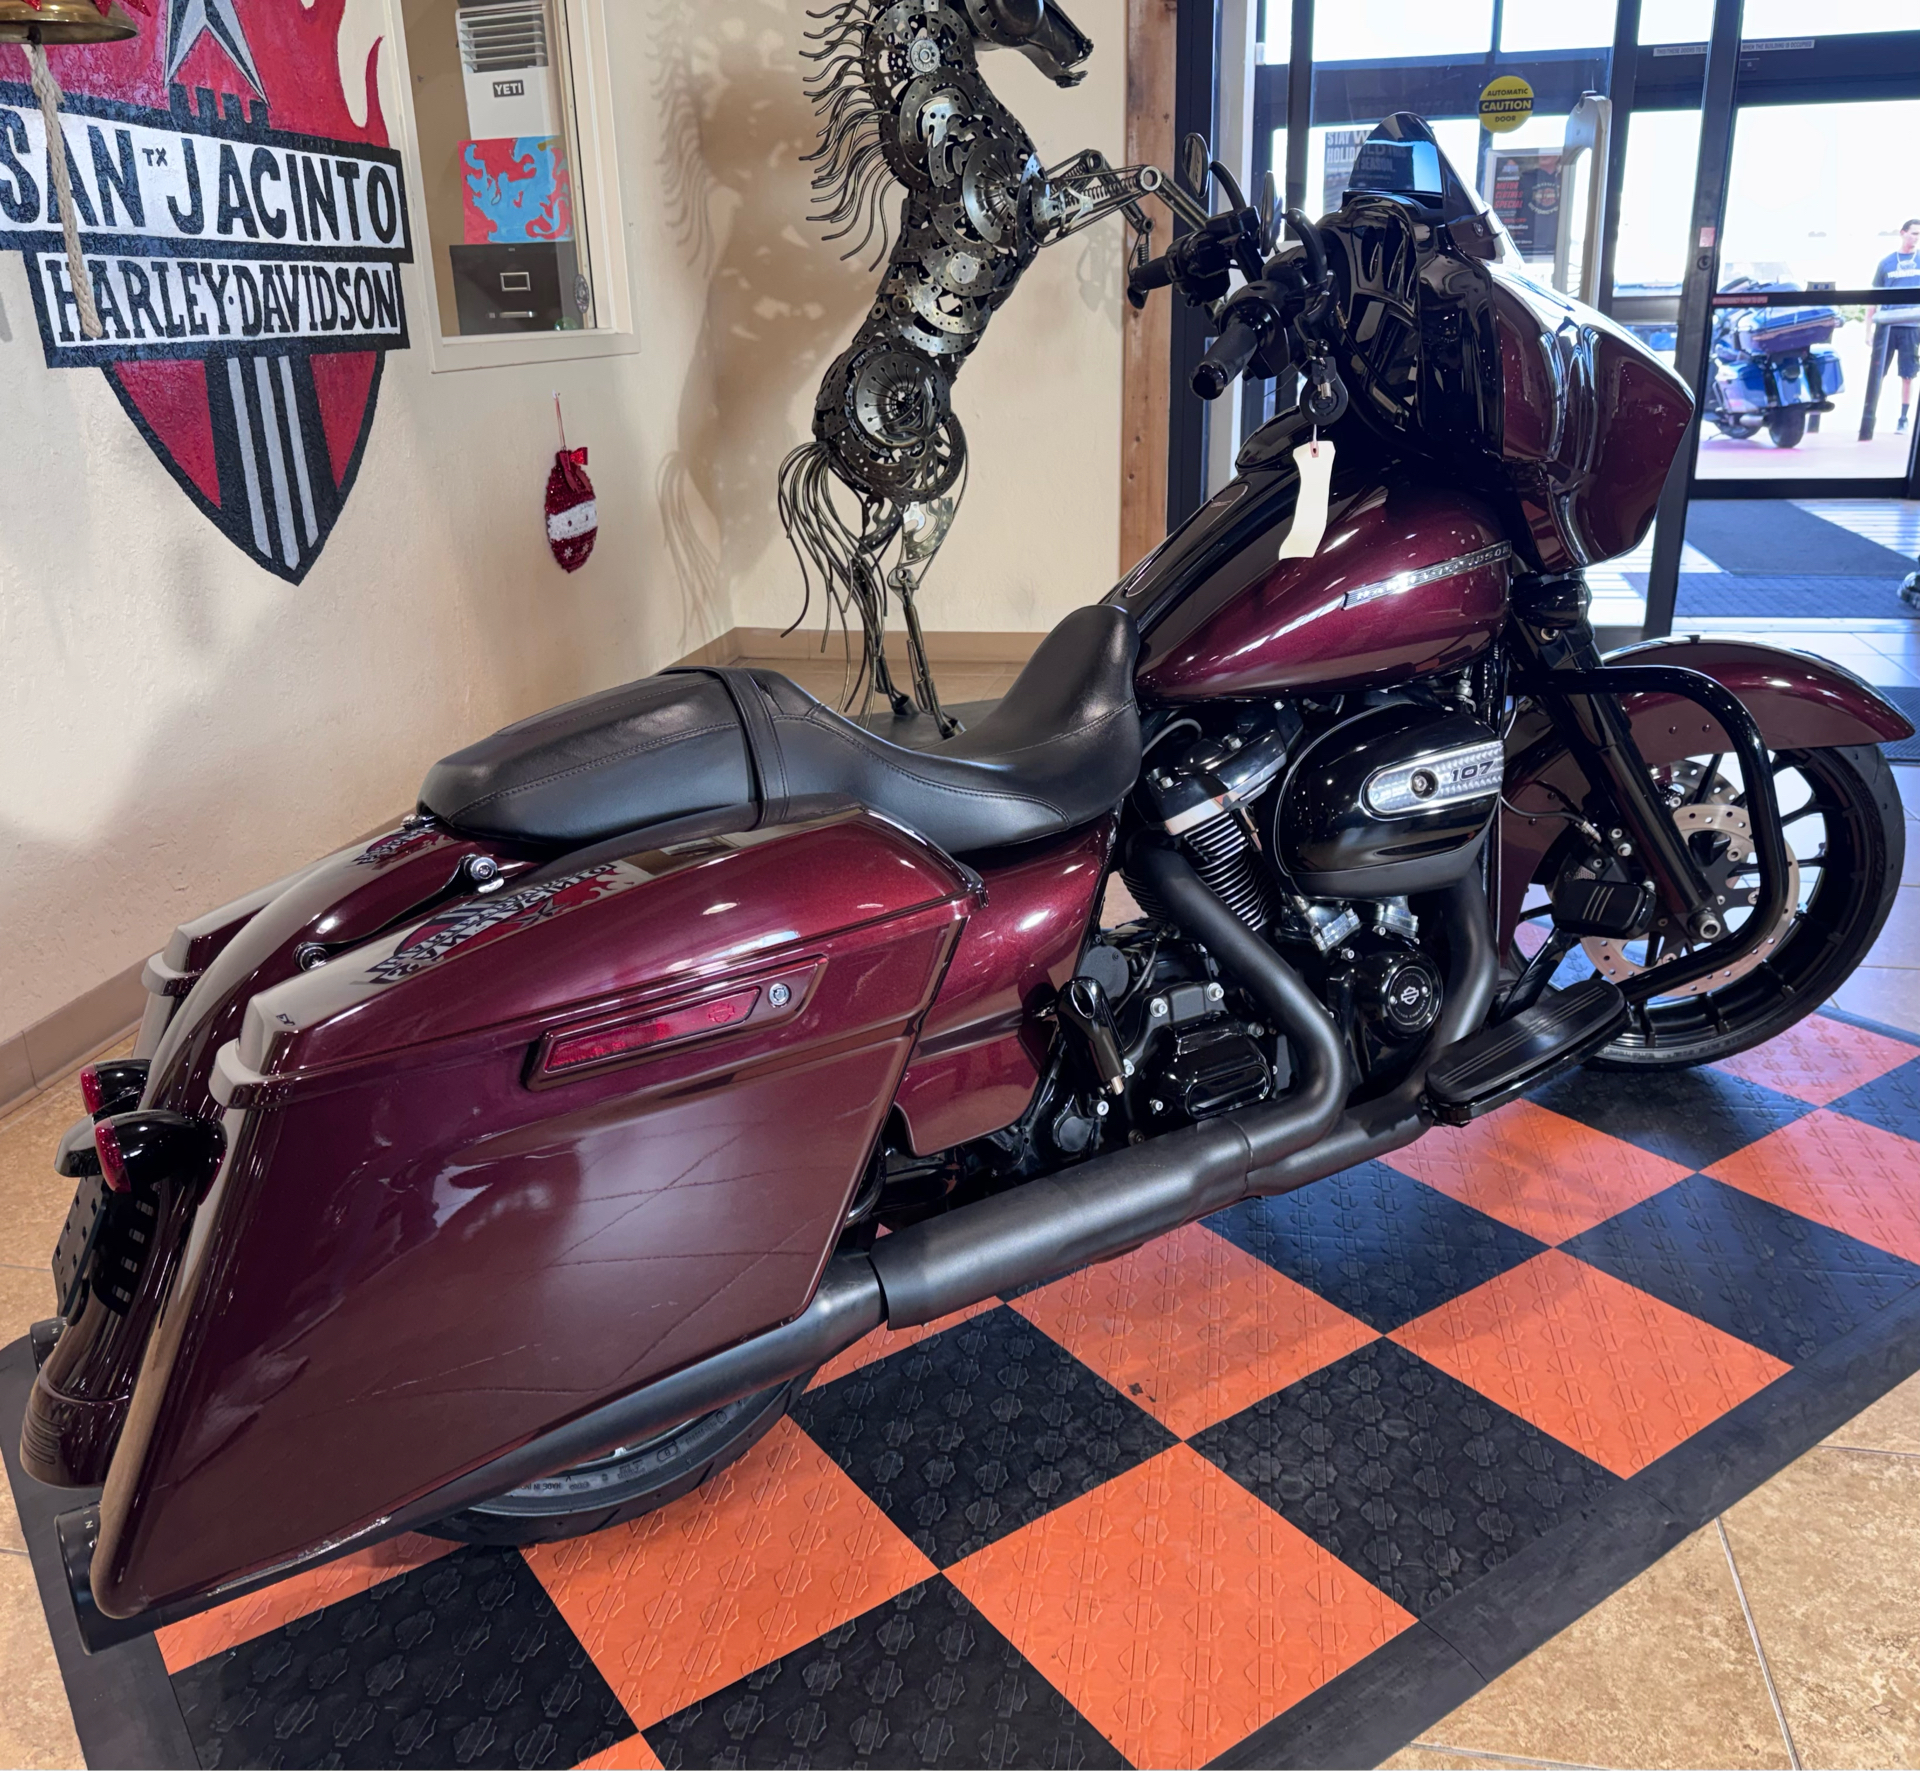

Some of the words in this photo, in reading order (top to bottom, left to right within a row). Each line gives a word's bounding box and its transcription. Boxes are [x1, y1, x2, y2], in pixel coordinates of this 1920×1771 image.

[494, 82, 522, 96] YETI
[1487, 88, 1529, 97] AUTOMATIC
[1481, 99, 1532, 112] CAUTION
[1326, 130, 1350, 145] STAY
[0, 108, 146, 228] SAN
[142, 147, 168, 167] TX
[166, 138, 397, 244] JACINTO
[1493, 200, 1524, 209] SPECIAL
[1450, 760, 1494, 782] 107
